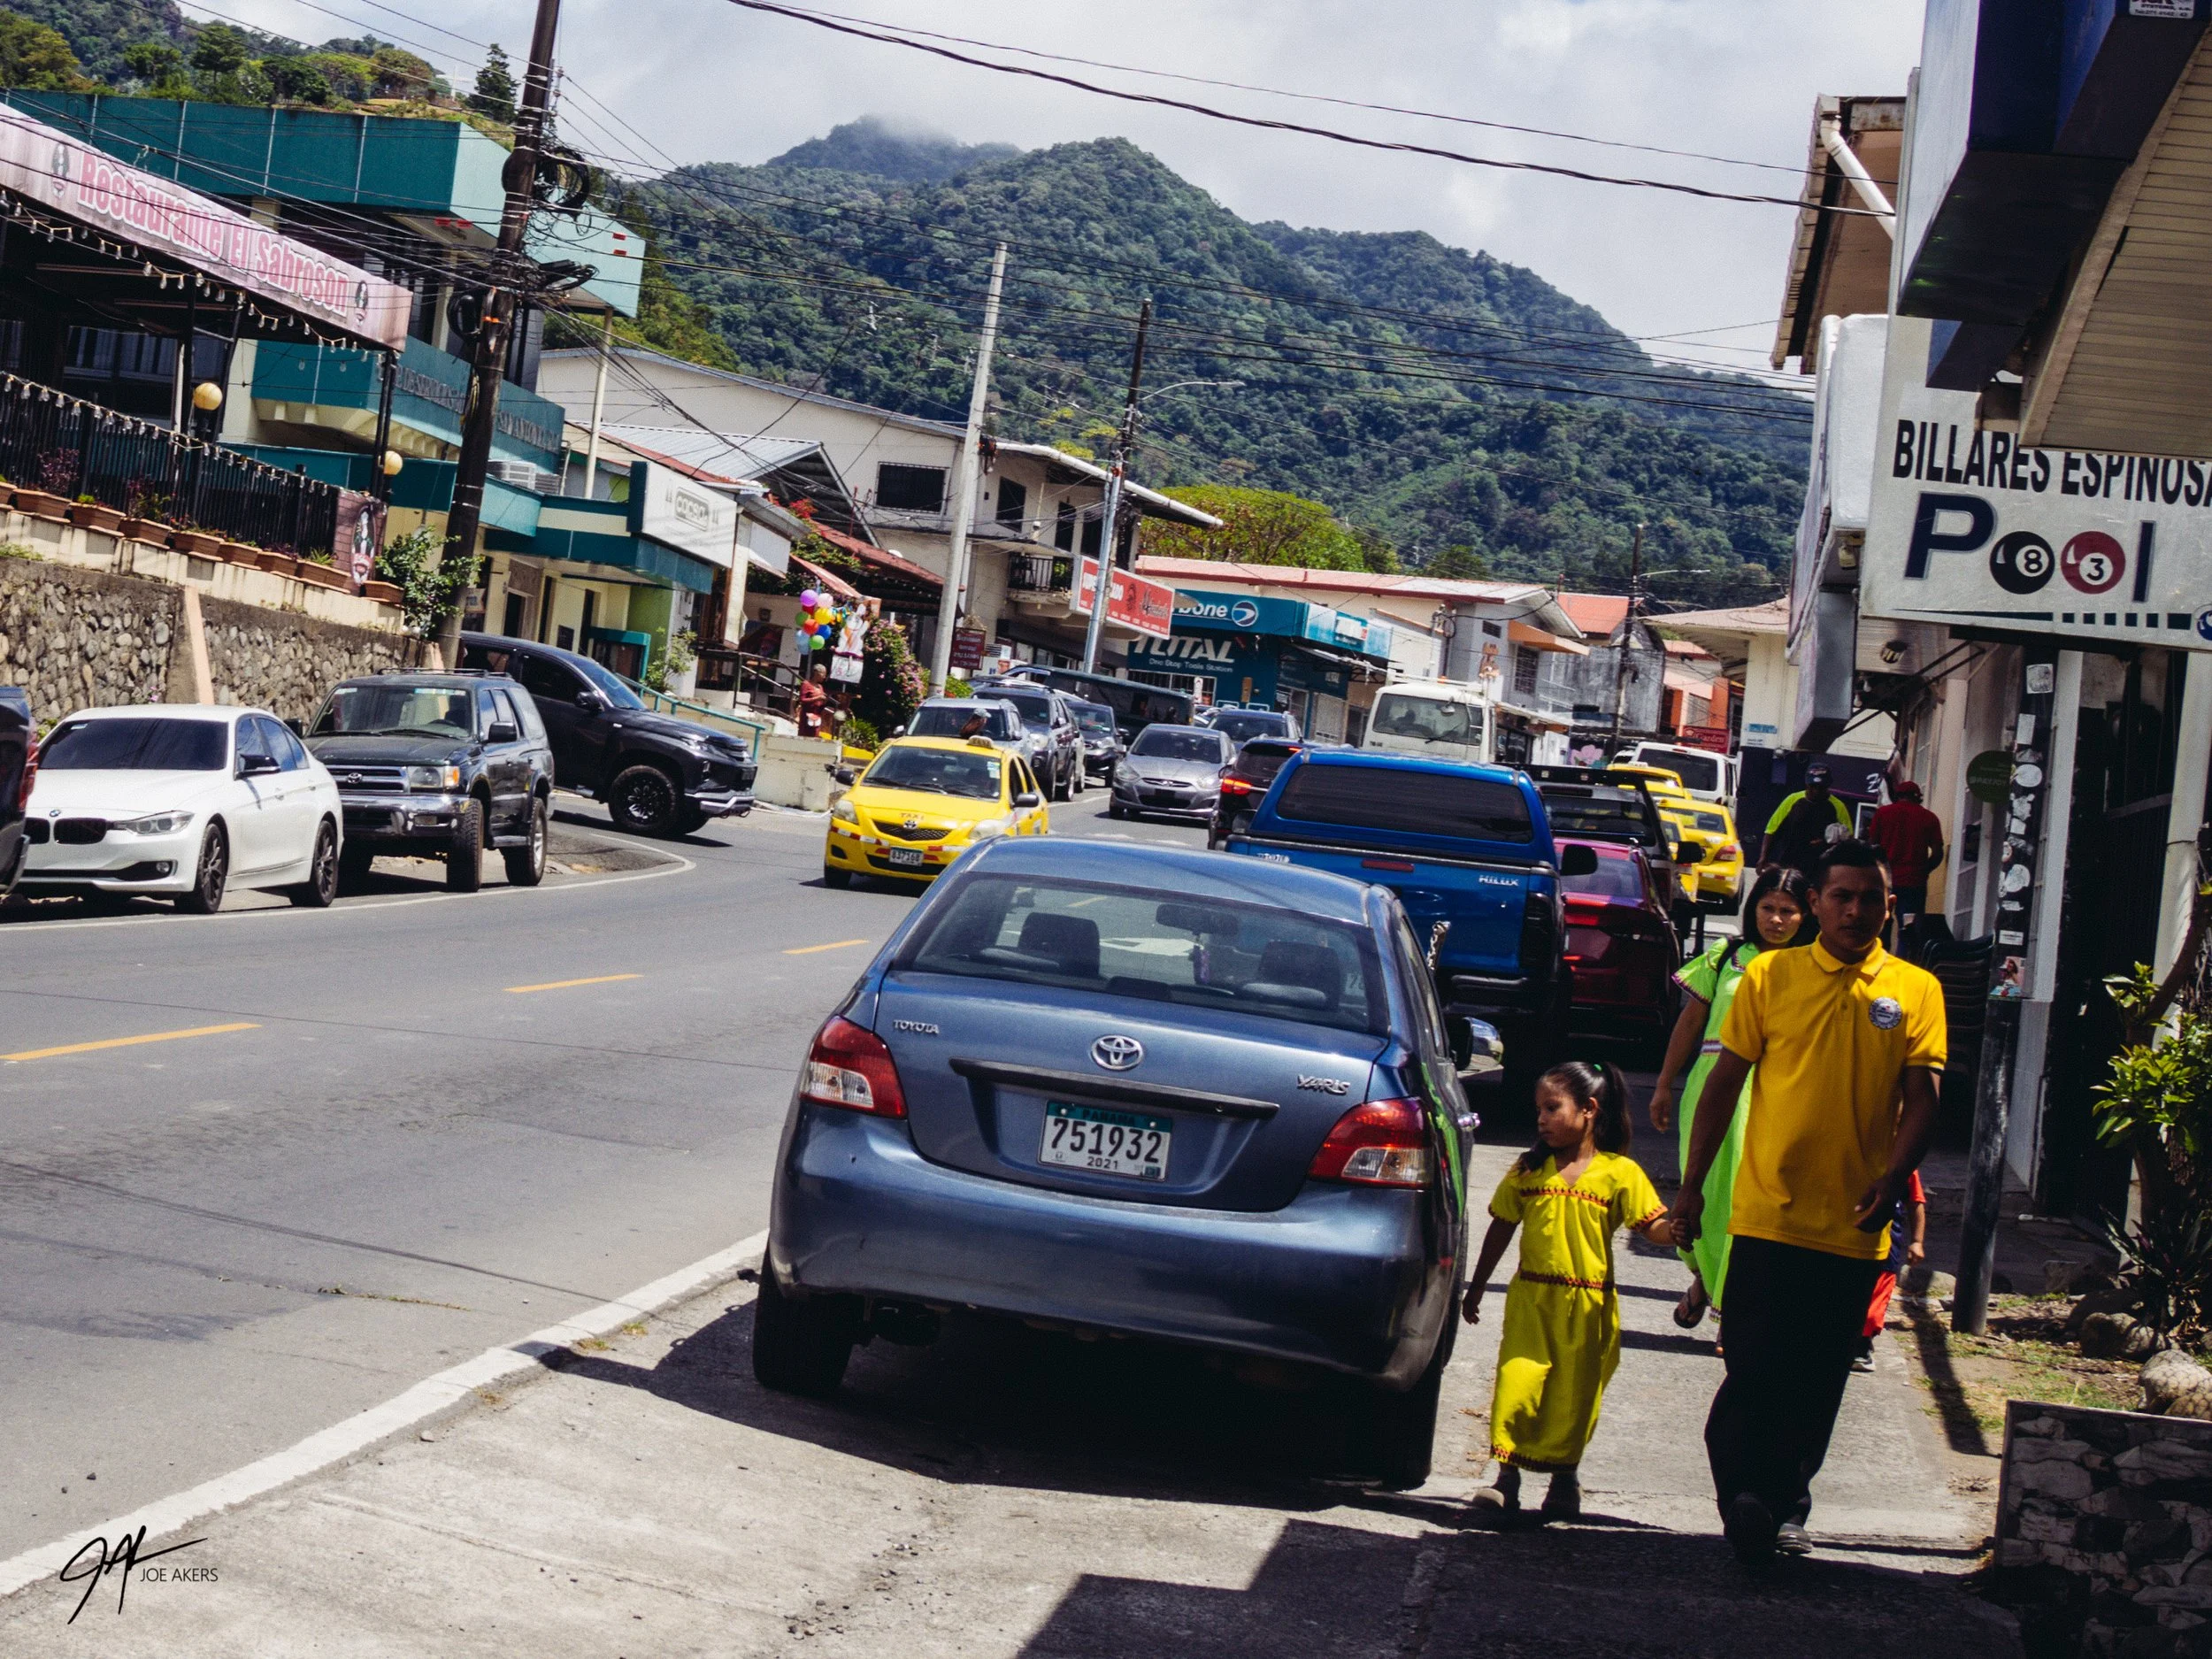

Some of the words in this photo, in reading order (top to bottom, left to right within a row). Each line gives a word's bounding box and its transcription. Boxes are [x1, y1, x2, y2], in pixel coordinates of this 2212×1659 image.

[78, 150, 223, 260] Restaurante
[228, 218, 252, 273] El
[256, 233, 349, 318] Sabroson
[1893, 419, 2051, 493] BILLARES
[1479, 875, 1518, 886] HILUX
[894, 1019, 939, 1033] TOYOTA
[1297, 1074, 1350, 1094] YARIS
[1051, 1118, 1162, 1164] 751932
[1087, 1156, 1118, 1169] 2021
